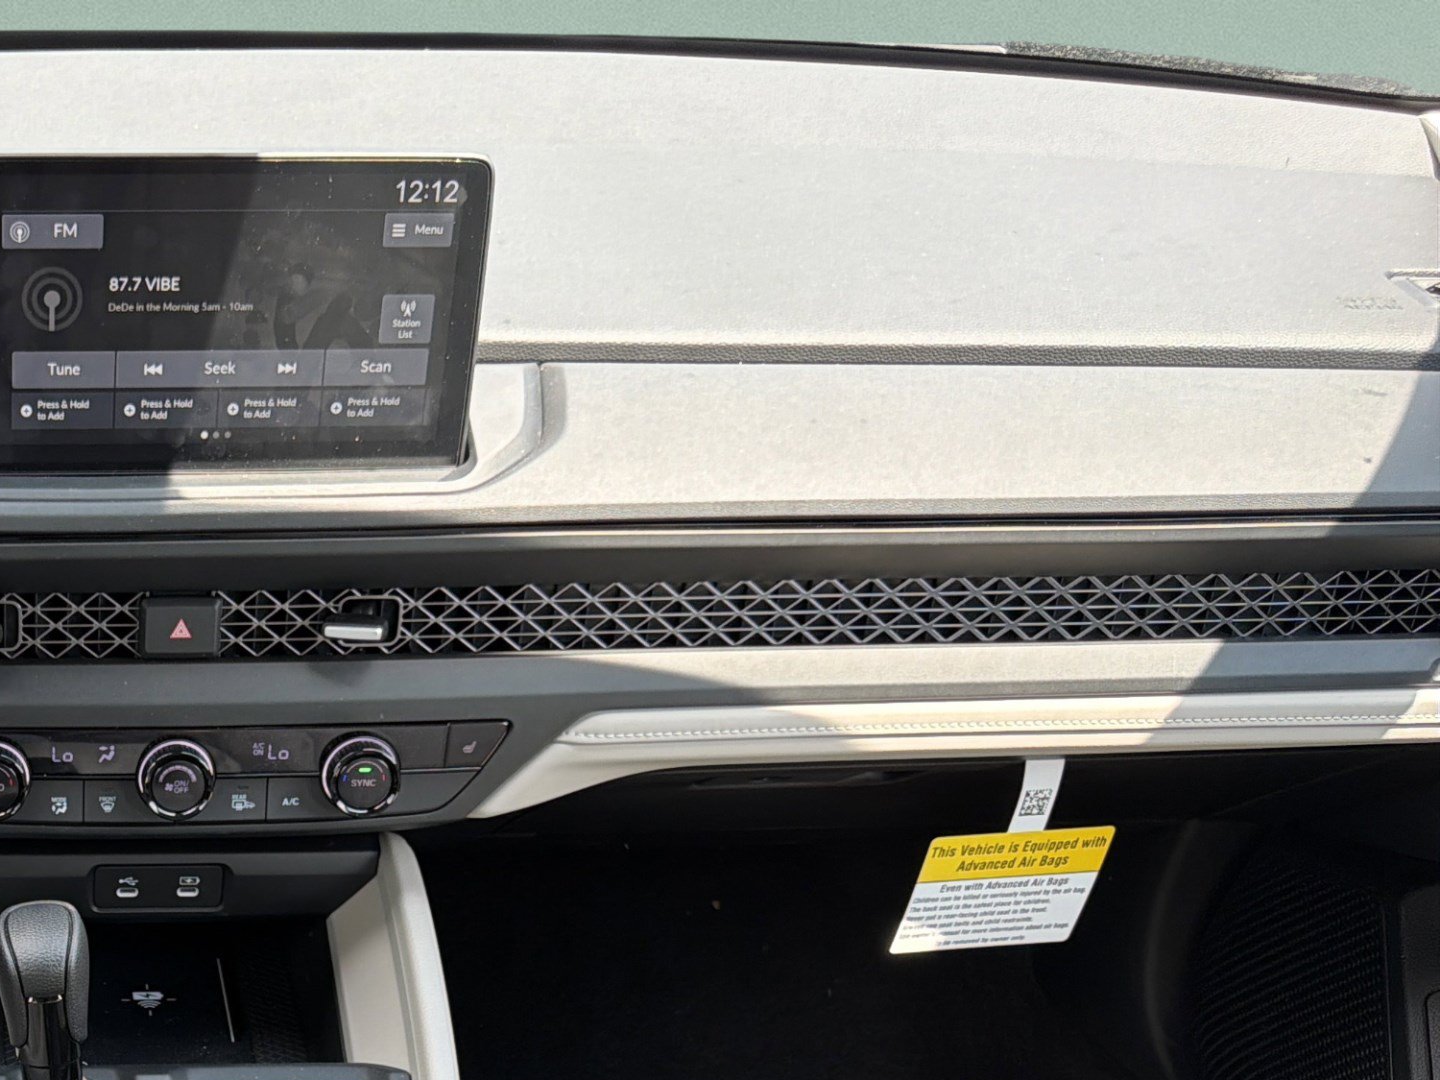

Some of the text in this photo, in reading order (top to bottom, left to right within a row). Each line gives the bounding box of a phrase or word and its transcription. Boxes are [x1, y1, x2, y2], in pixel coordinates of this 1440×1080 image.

[395, 180, 459, 203] 12:12
[53, 223, 78, 238] FM
[414, 224, 444, 235] Menu
[109, 277, 180, 292] 87.7 VIBE
[108, 302, 134, 312] DeDe
[136, 302, 144, 312] in
[146, 302, 160, 312] the
[163, 302, 200, 313] Morning
[202, 302, 220, 312] 5am
[229, 302, 254, 311] 10am
[392, 319, 421, 328] Station
[398, 331, 413, 339] List
[47, 363, 81, 376] Tune
[204, 361, 236, 375] Seek
[360, 360, 391, 374] Scan
[37, 400, 60, 409] Press
[70, 400, 90, 409] Hold
[141, 399, 163, 408] Press
[173, 399, 193, 408] Hold
[244, 399, 266, 408] Press
[277, 398, 297, 407] Hold
[348, 397, 370, 406] Press
[380, 397, 400, 406] Hold
[48, 412, 65, 420] Add
[140, 411, 168, 420] to Add
[254, 410, 271, 418] Add
[347, 409, 374, 418] to Add
[52, 747, 73, 763] Lo
[267, 744, 289, 760] Lo
[351, 778, 376, 788] SYNC
[174, 786, 188, 794] OFF
[282, 797, 299, 806] A/C
[931, 836, 1107, 858] This Vehicle is Equipped with
[956, 855, 1069, 872] Advanced Air Bags
[940, 877, 1069, 893] Even with Advanced Air Bags
